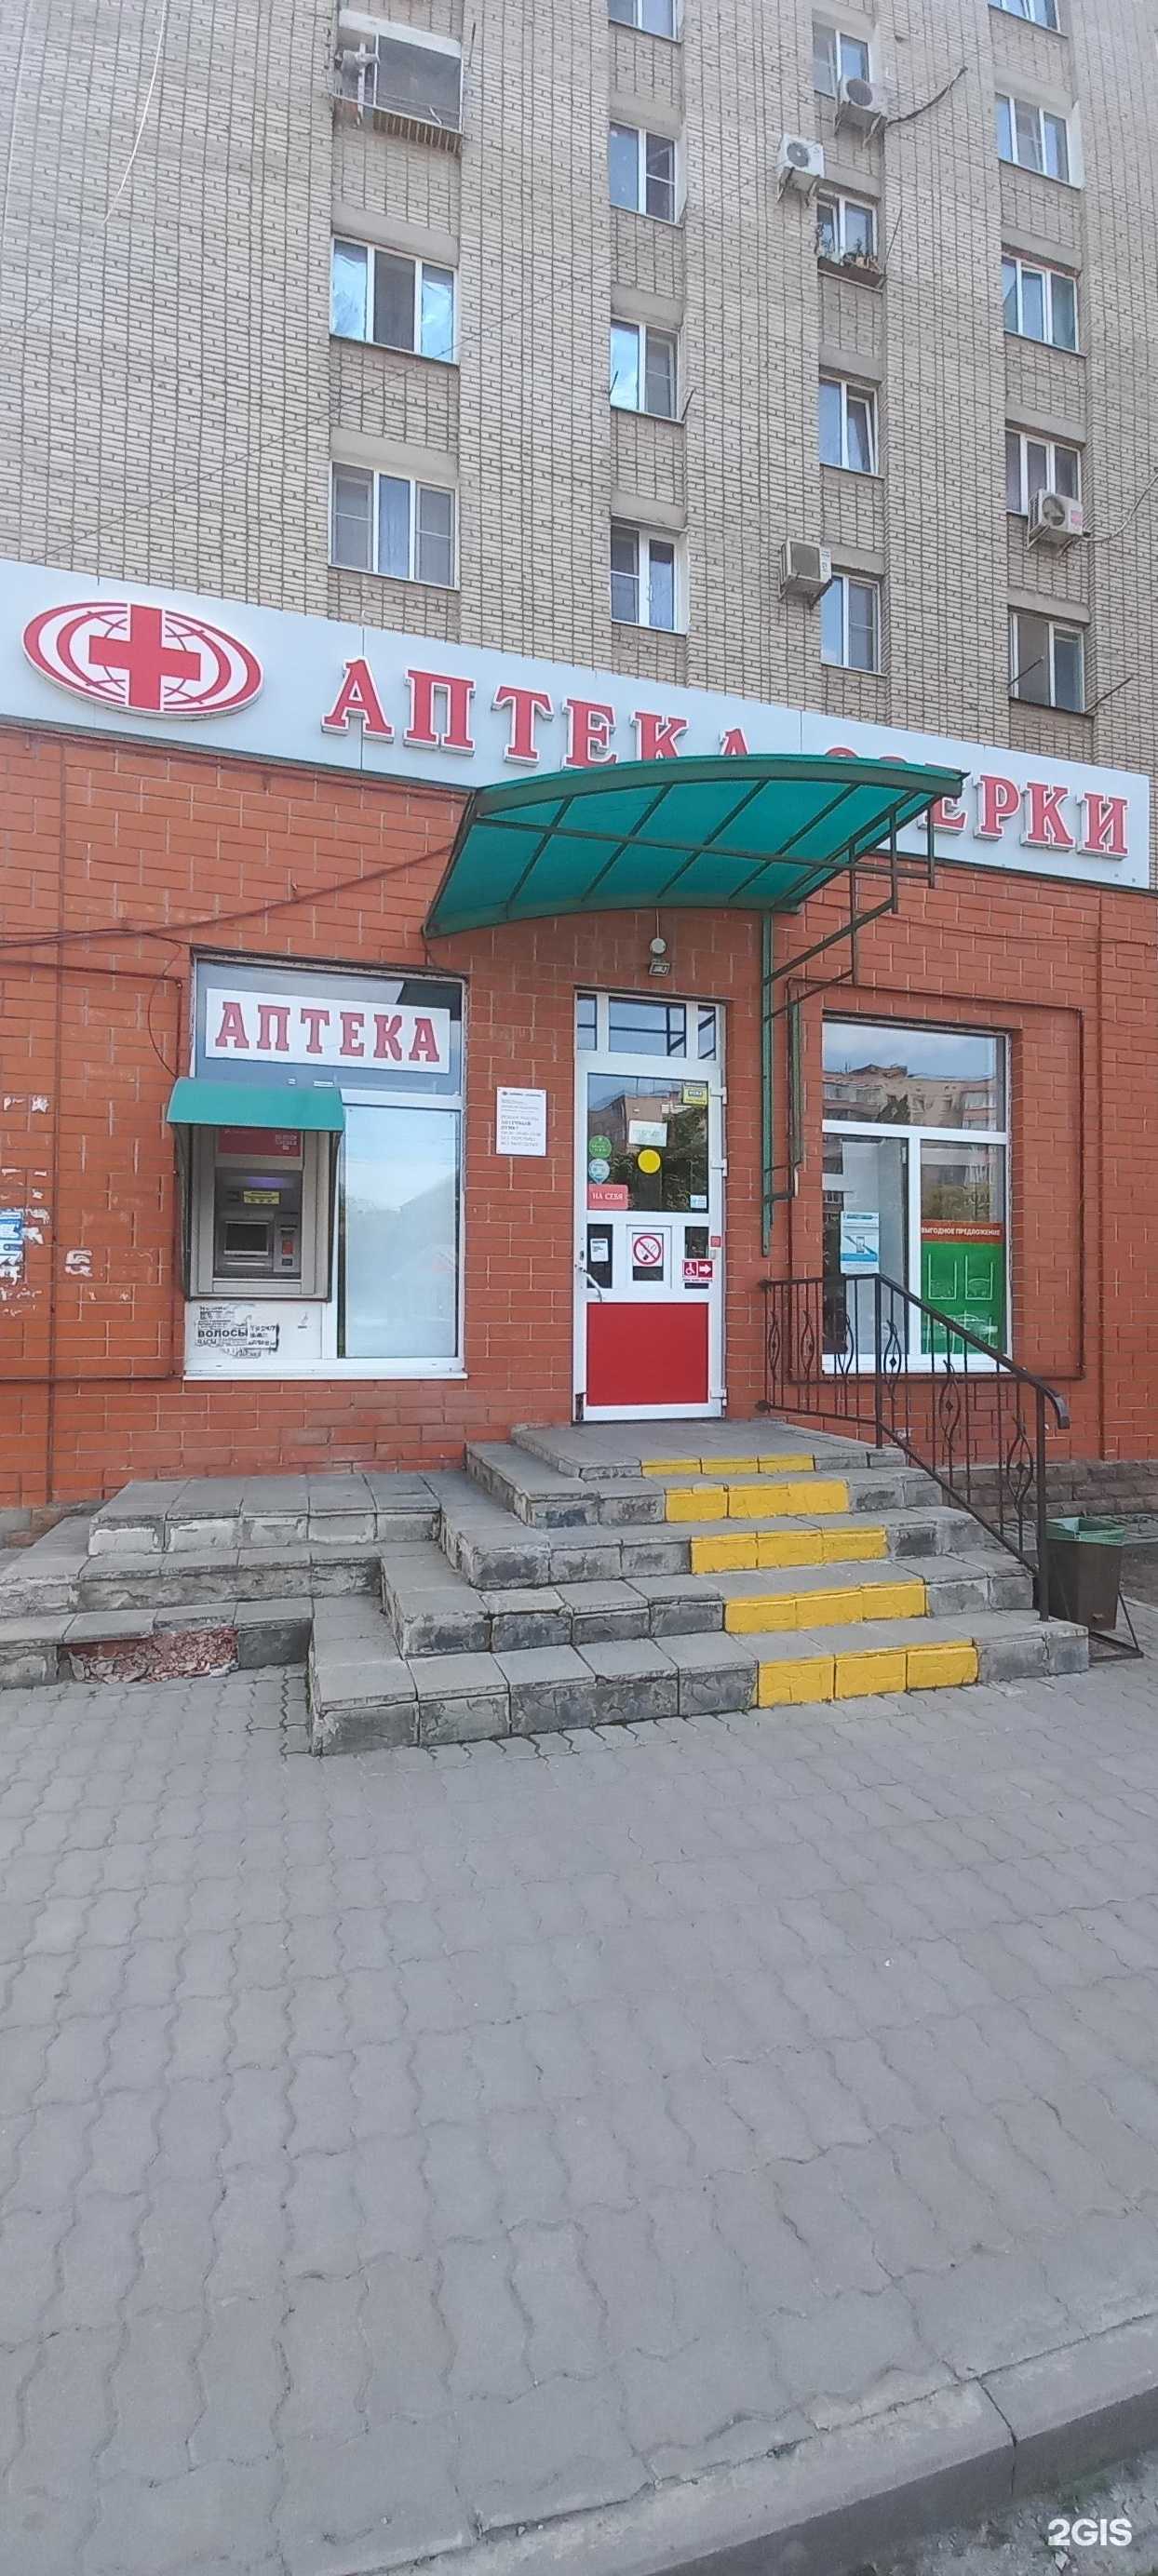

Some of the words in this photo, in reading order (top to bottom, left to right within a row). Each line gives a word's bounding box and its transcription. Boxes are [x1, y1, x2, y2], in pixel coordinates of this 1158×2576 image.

[825, 746, 1130, 861] РКИ
[215, 1000, 439, 1063] АПТЕКА
[921, 1227, 954, 1235] ВЫГОДНОЕ
[955, 1228, 1001, 1237] ПРЕДЛОЖЕНИЕ
